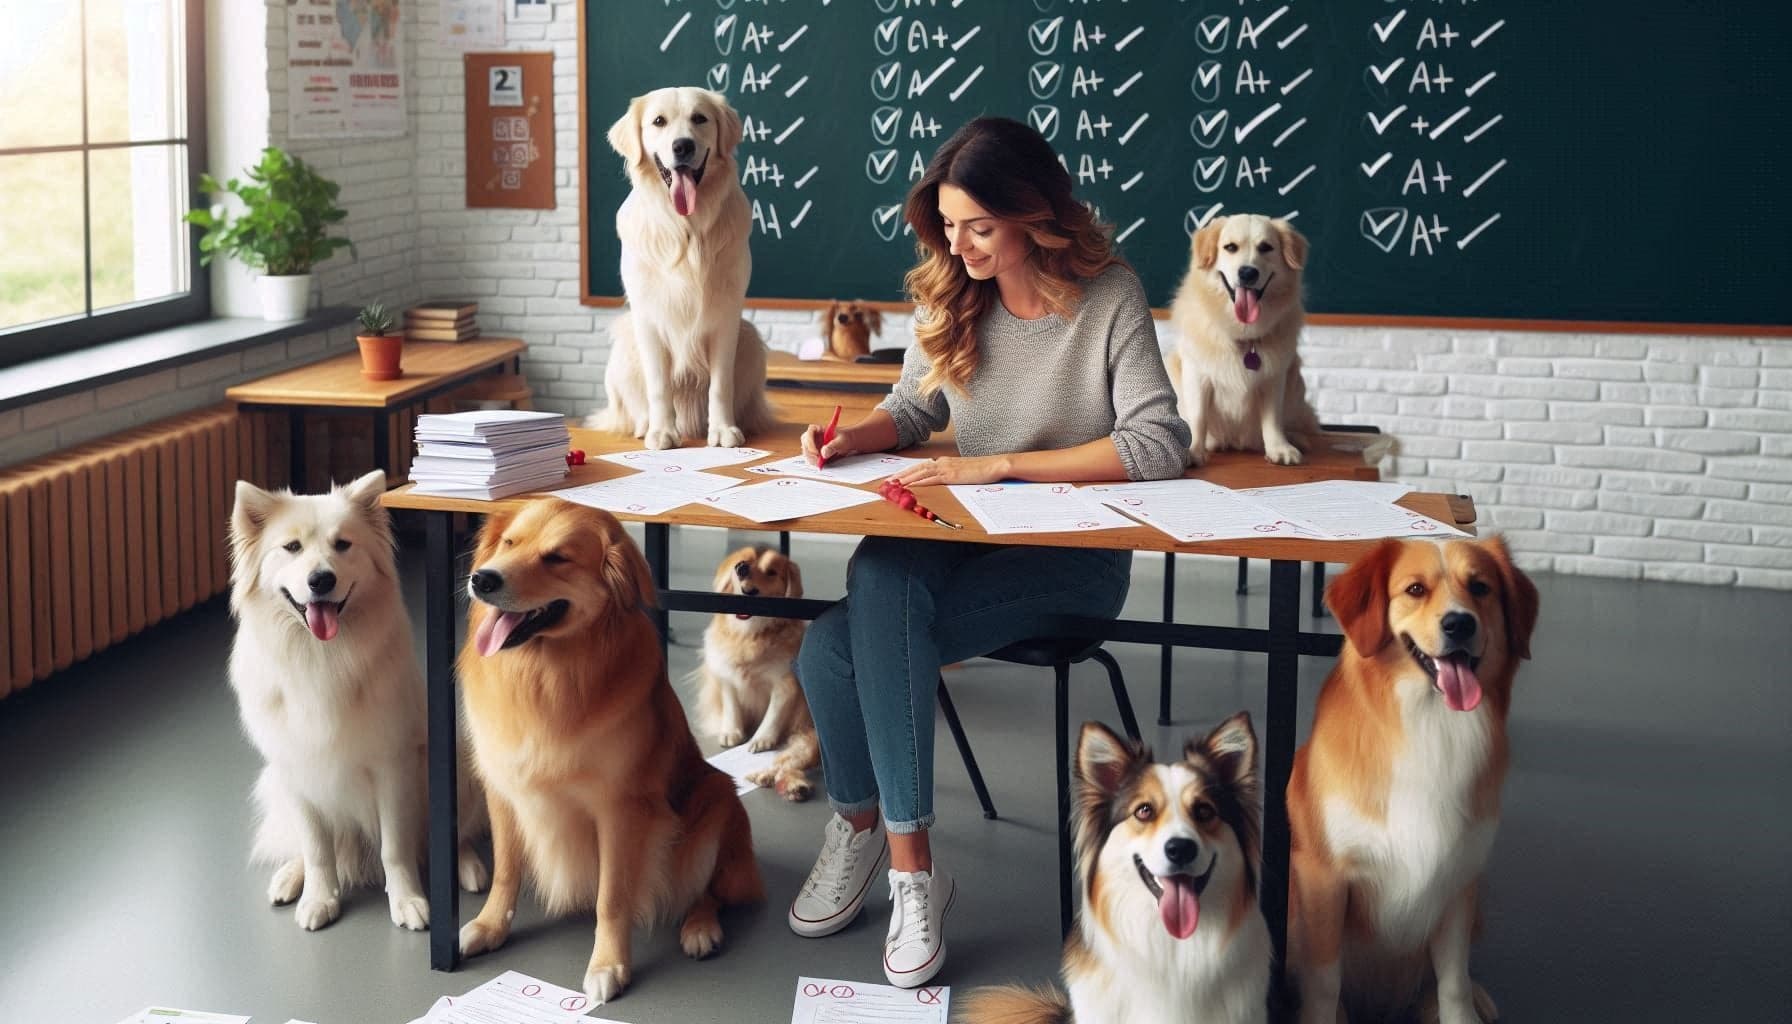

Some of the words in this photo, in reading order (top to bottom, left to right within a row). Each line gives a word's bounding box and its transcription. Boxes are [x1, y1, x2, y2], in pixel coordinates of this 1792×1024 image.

[742, 22, 774, 53] A+
[1073, 19, 1107, 53] A+
[1416, 17, 1459, 50] A+
[494, 69, 516, 91] 2
[1071, 65, 1104, 98] A+
[1235, 60, 1271, 95] A+
[1408, 61, 1454, 94] A+
[742, 114, 772, 142] A+
[909, 111, 942, 139] A+
[1076, 109, 1112, 140] A+
[1079, 154, 1114, 186] A+
[1235, 156, 1272, 188] A+
[1401, 158, 1452, 195] A+
[1409, 214, 1450, 256] A+
